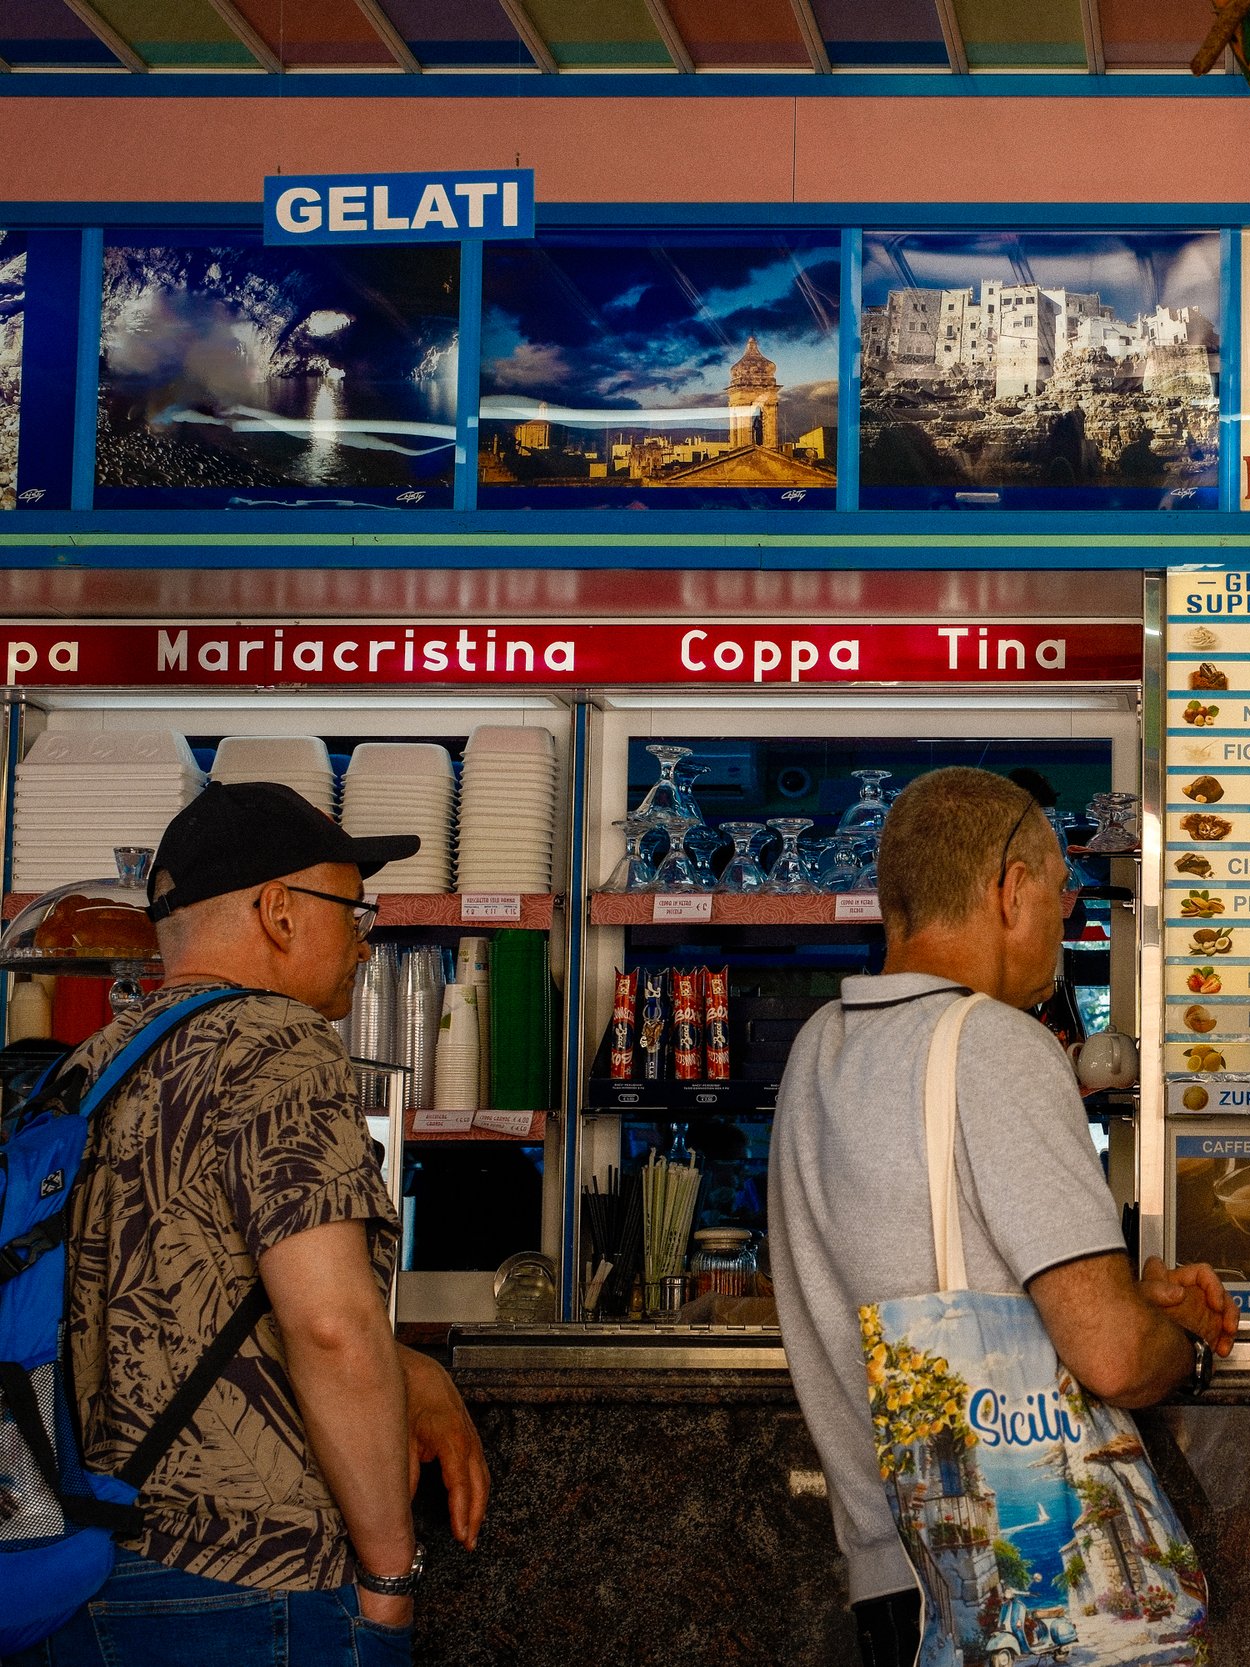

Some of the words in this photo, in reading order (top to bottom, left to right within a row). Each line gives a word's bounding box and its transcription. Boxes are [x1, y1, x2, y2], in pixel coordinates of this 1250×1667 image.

[275, 182, 519, 234] GELATI
[157, 628, 576, 673] Mariacristina
[681, 629, 861, 684] Coppa
[938, 628, 1067, 672] Tina
